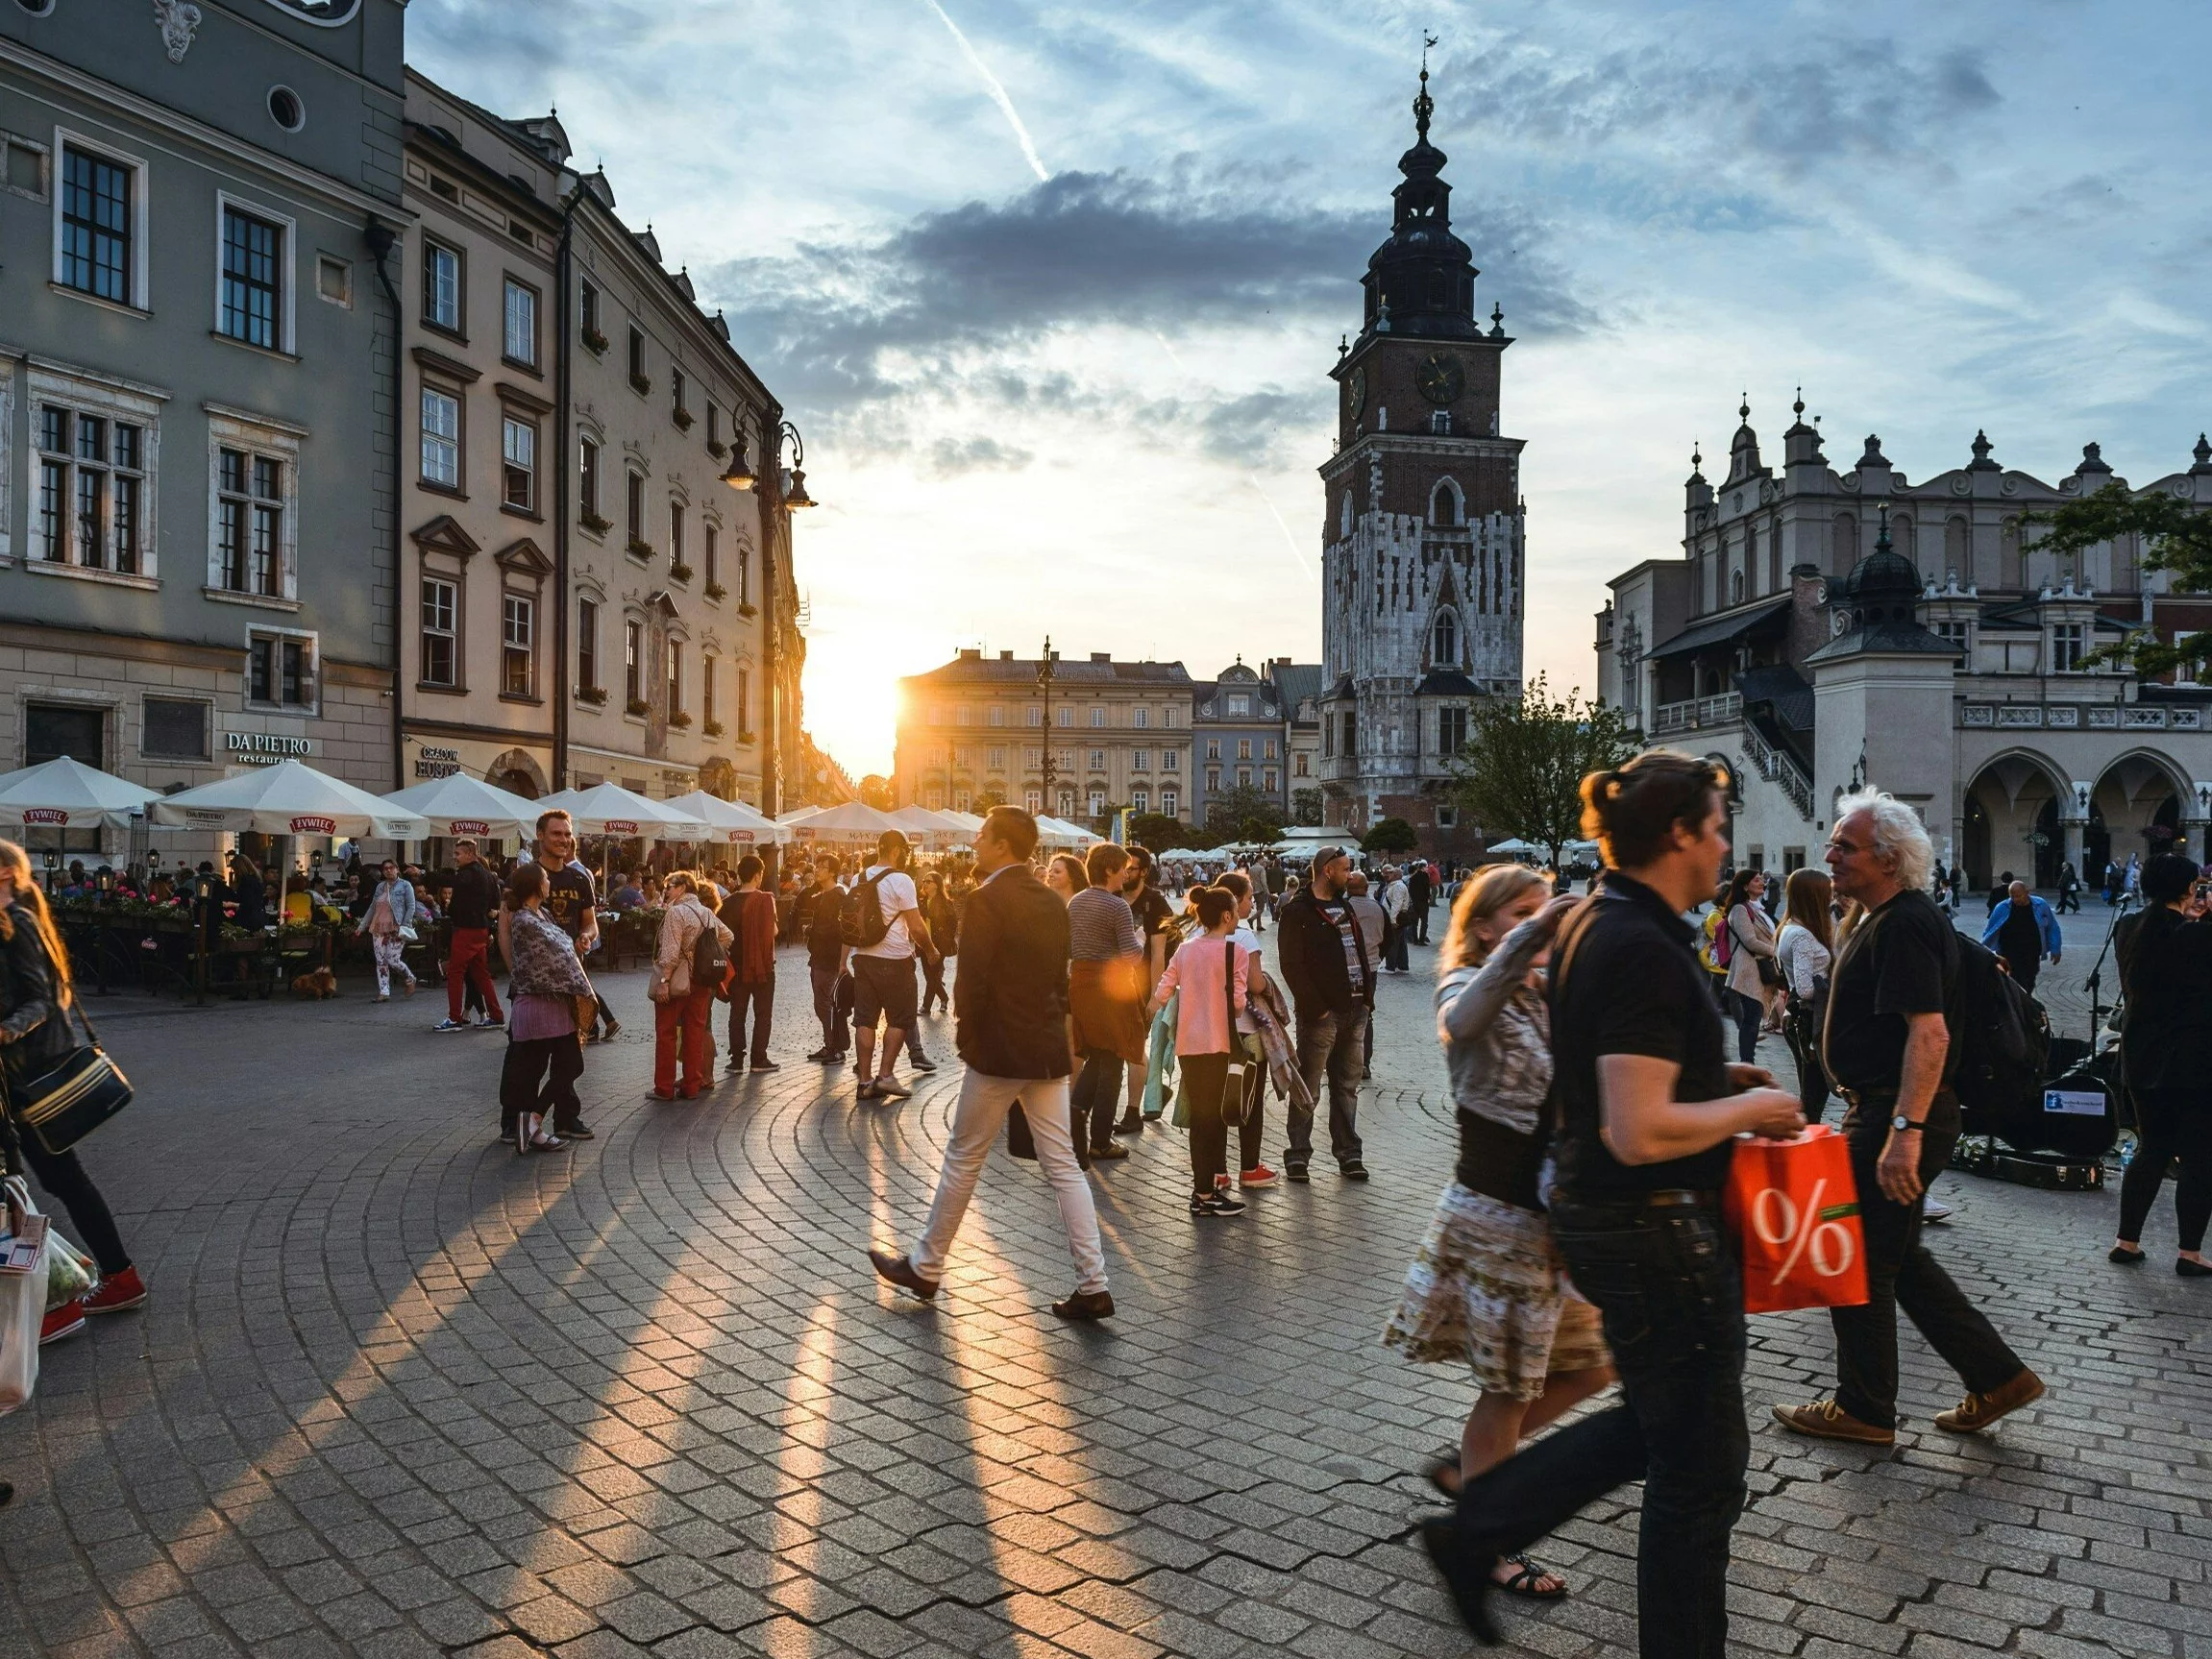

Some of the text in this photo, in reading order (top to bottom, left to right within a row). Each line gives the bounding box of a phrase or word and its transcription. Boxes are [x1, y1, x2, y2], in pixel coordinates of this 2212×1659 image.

[227, 733, 311, 755] DA PIETRO
[421, 746, 459, 761] CRACOW
[29, 810, 62, 821] ŻYWIEC
[198, 812, 225, 820] PIETRO
[296, 817, 332, 830] ŻYWIEC
[455, 821, 485, 832] ŻYWIEC
[1752, 1178, 1856, 1286] %
